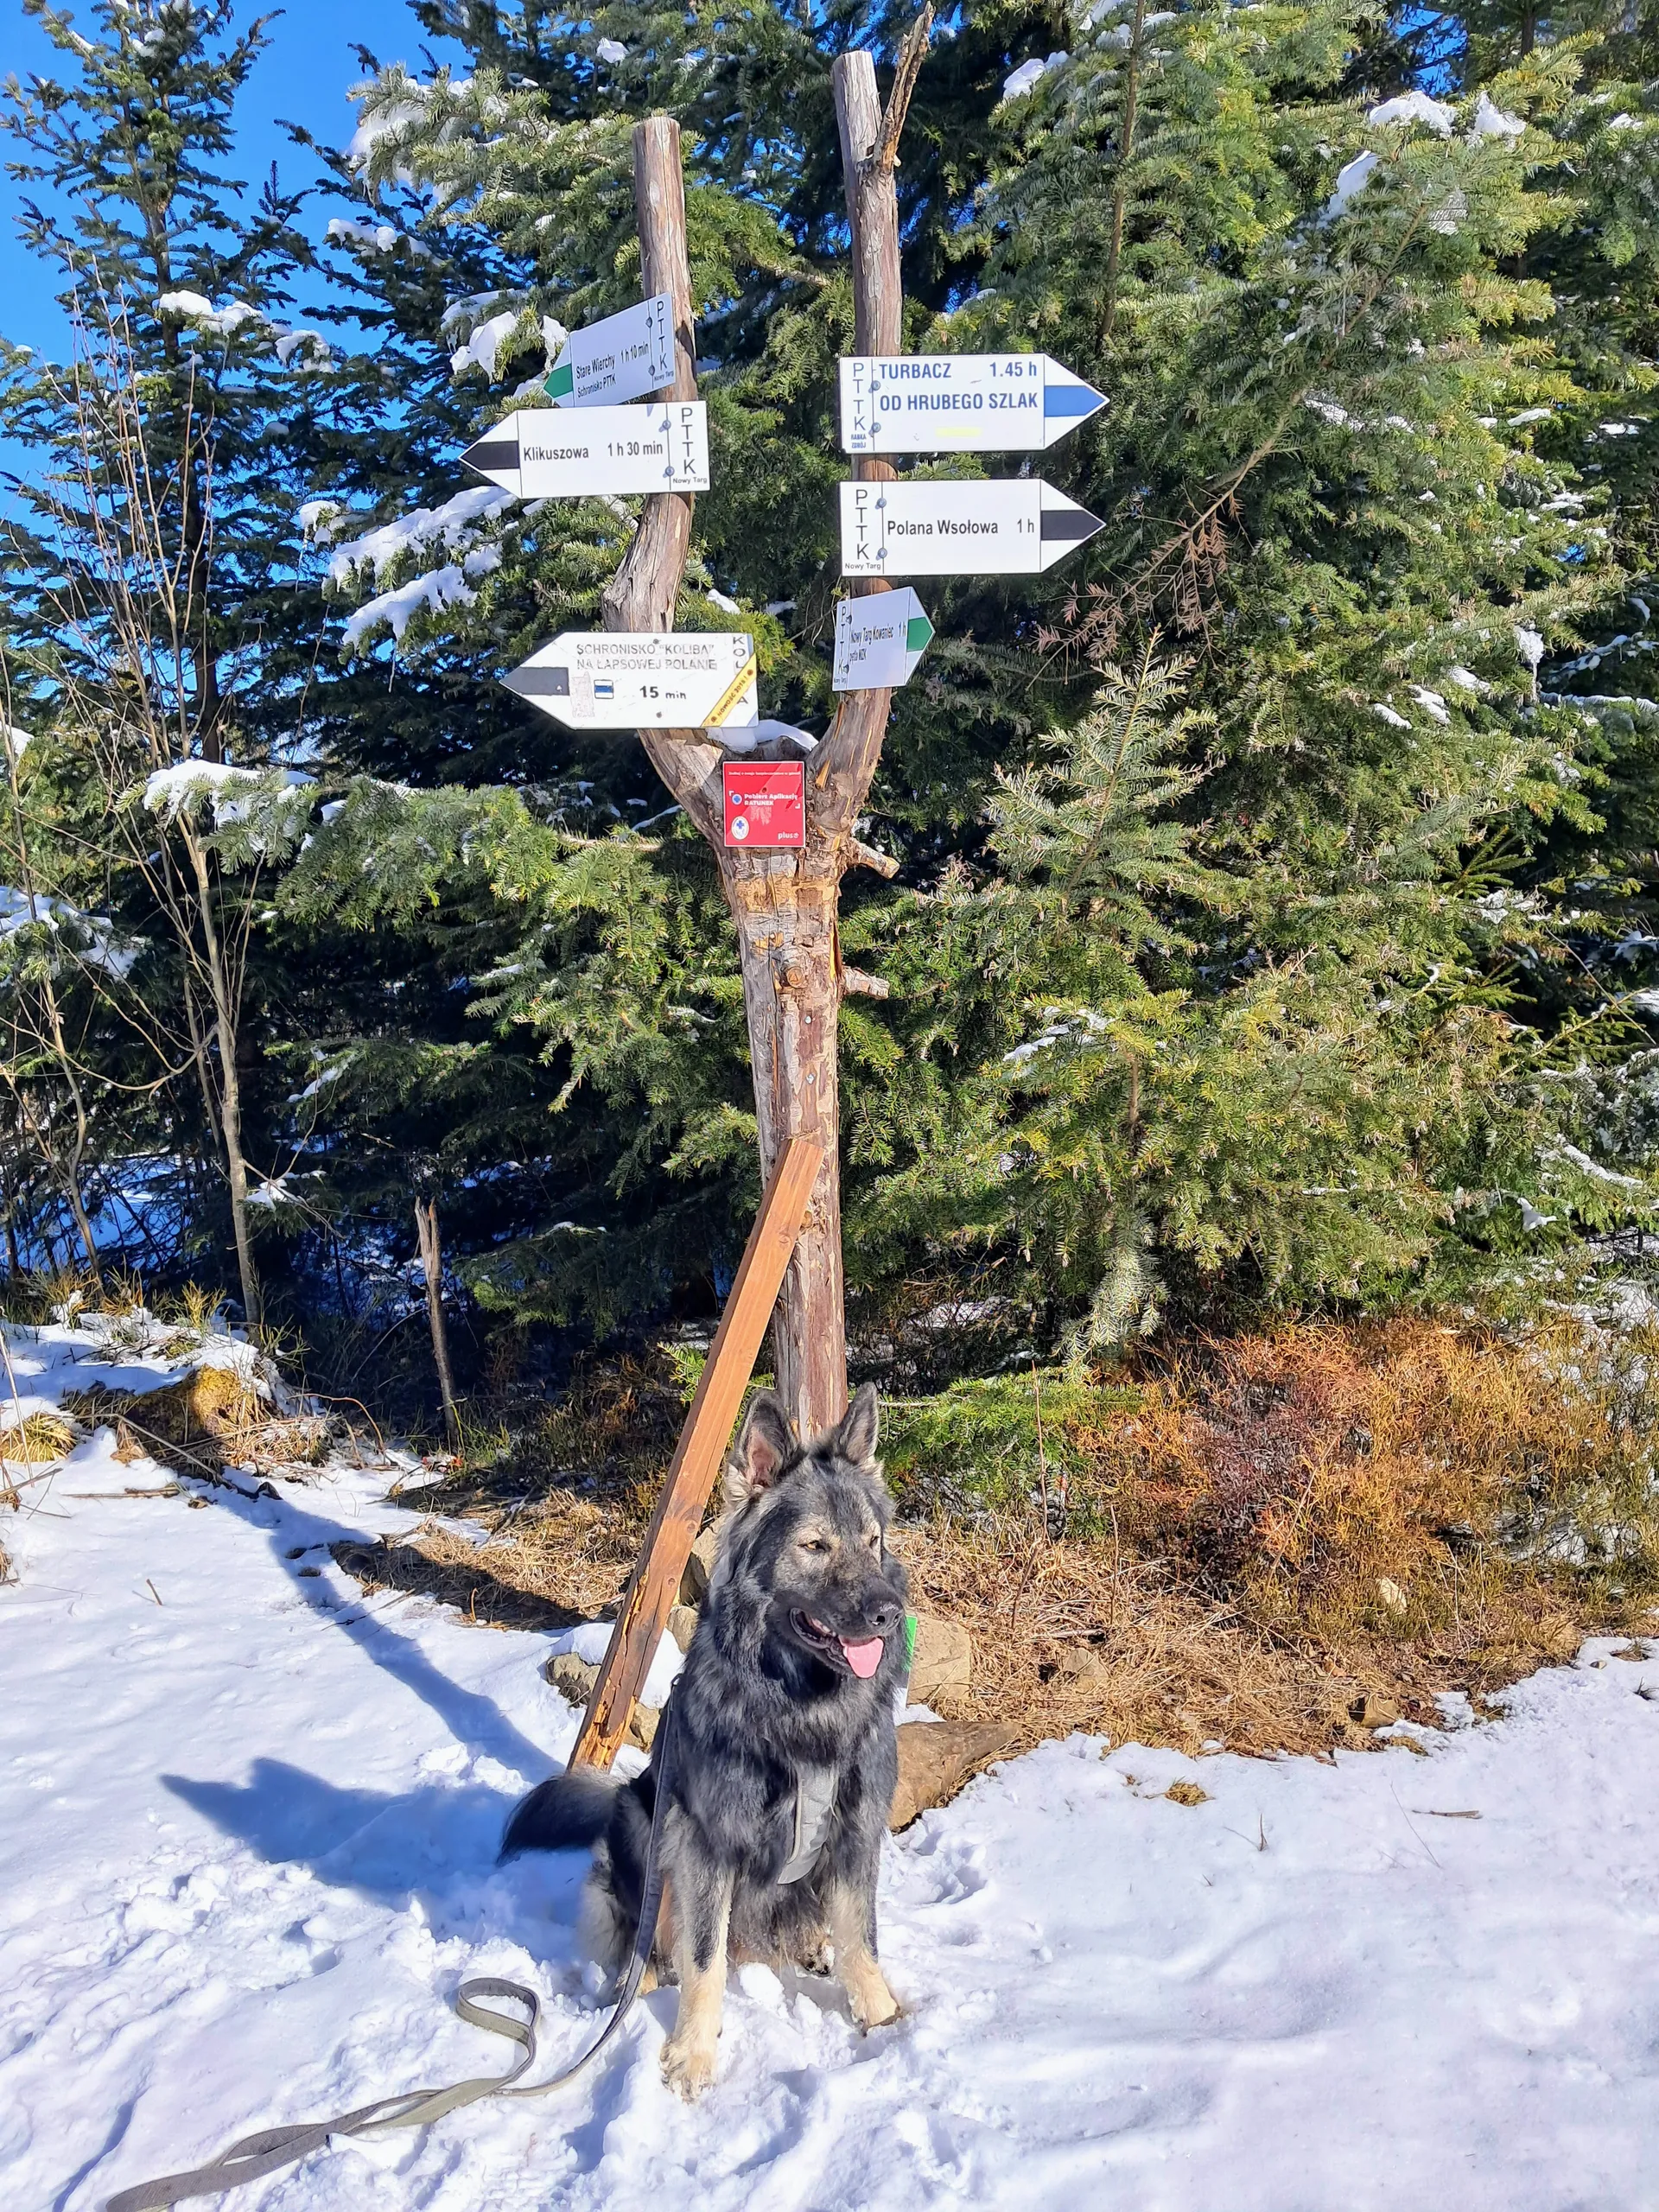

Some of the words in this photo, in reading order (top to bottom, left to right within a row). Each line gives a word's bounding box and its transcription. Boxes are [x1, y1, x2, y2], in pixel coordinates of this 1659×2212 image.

[657, 301, 667, 371] PTTK
[576, 365, 591, 379] Stare
[591, 354, 615, 373] Wierchy
[625, 349, 629, 362] h
[631, 345, 638, 359] 10
[639, 340, 649, 357] min
[879, 363, 952, 378] TURBACZ
[989, 361, 1023, 378] 1.45
[1029, 361, 1038, 377] h
[577, 380, 602, 397] Schronisko
[603, 373, 616, 389] PTTK
[853, 363, 866, 431] PTTK
[880, 395, 901, 410] OD
[907, 393, 983, 410] HRUBEGO
[988, 392, 1039, 409] SZLAK
[681, 407, 696, 475] PTTK
[524, 446, 589, 461] Klikuszowa
[607, 443, 612, 456] 1
[617, 442, 624, 455] h
[627, 442, 639, 456] 30
[643, 441, 664, 455] min
[855, 489, 869, 560] PTTK
[887, 520, 933, 535] Polana
[937, 518, 998, 534] Wsołowa
[1017, 519, 1022, 533] 1
[1027, 518, 1034, 533] h
[866, 563, 881, 571] Targ
[576, 644, 656, 655] SCHRONISKO
[577, 658, 594, 670] NA
[597, 658, 662, 670] ŁAPSOWEJ
[665, 658, 718, 671] POLANIE
[733, 636, 748, 704] KOLA
[639, 685, 659, 698] 15
[665, 690, 687, 700] min
[778, 831, 793, 840] plus
